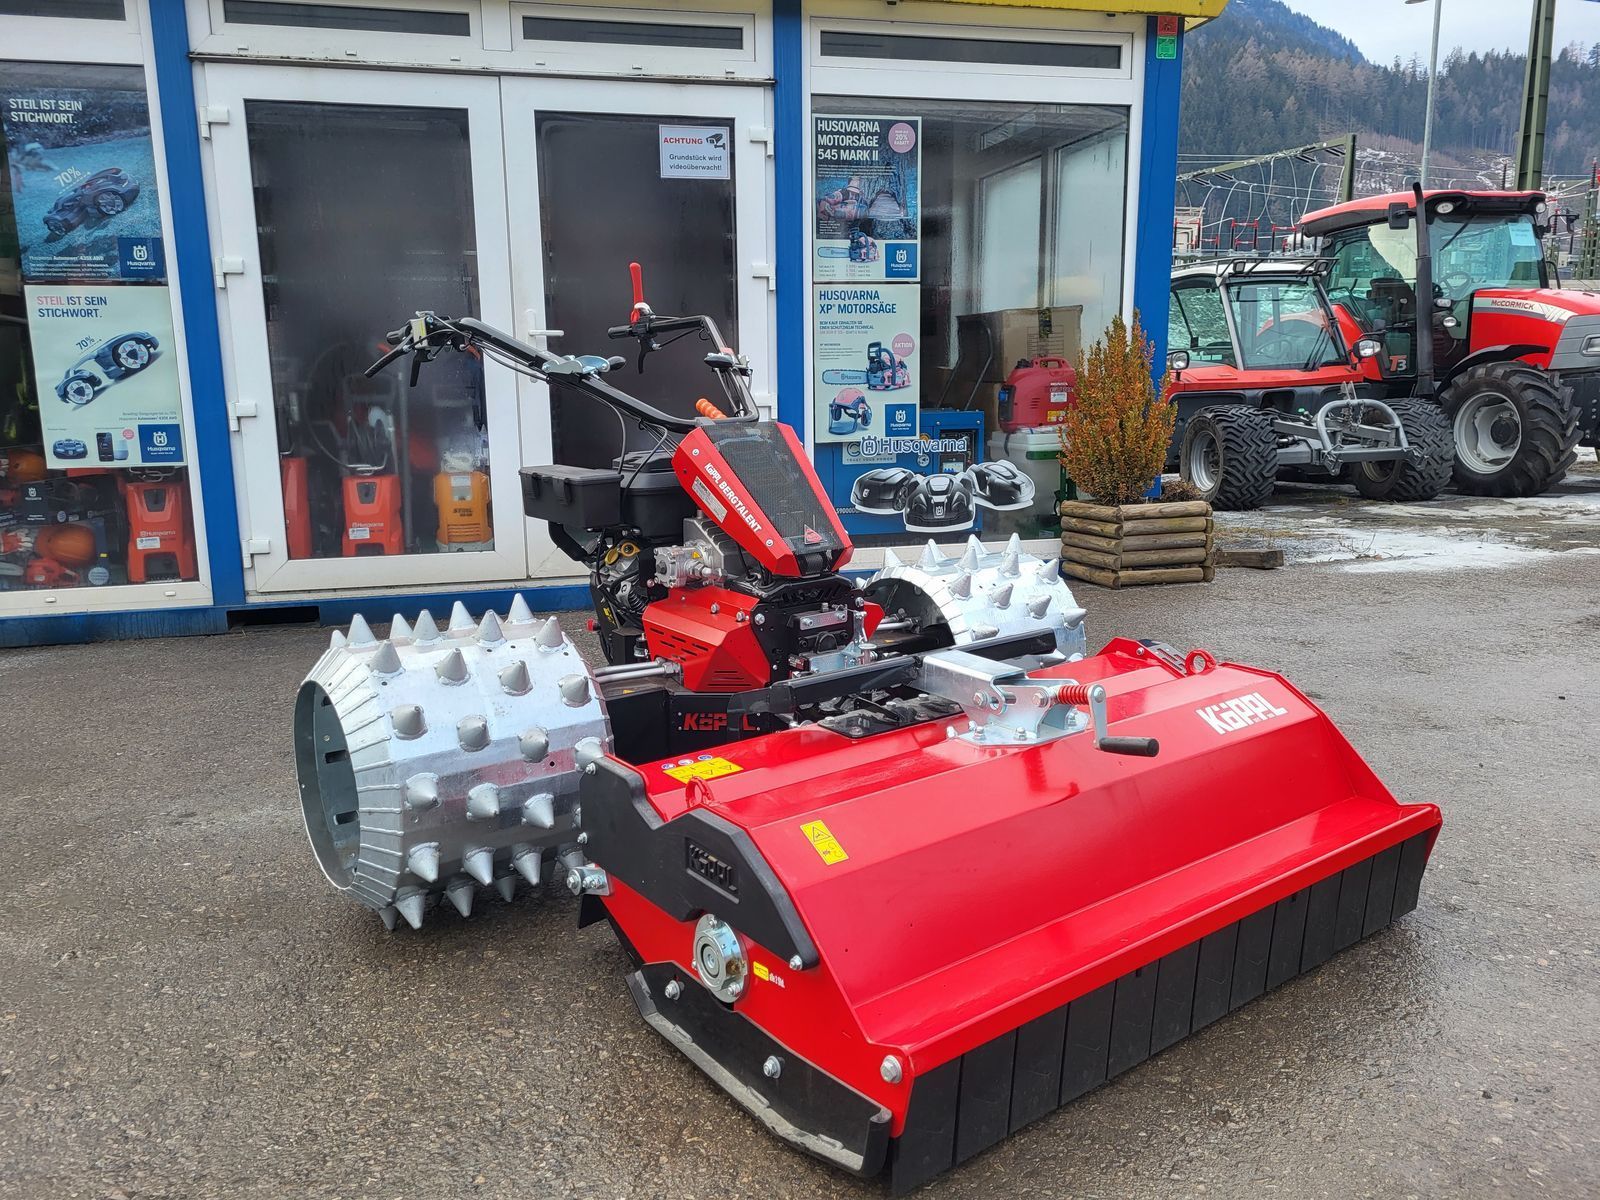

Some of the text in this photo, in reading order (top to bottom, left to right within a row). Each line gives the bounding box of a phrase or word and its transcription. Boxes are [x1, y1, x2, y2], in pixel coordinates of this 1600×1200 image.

[8, 98, 82, 111] STEIL IST SEIN
[11, 111, 78, 123] STICHWORT.
[817, 120, 881, 132] HUSQVARNA
[817, 133, 879, 146] MOTORSÄGE
[818, 149, 838, 160] 545
[840, 149, 870, 160] MARK
[53, 166, 81, 187] 70%
[36, 296, 108, 306] STEIL IST SEIN
[819, 290, 880, 301] HUSQVARNA
[38, 308, 102, 318] STICHWORT.
[837, 301, 897, 314] MOTORSÄGE
[75, 336, 95, 350] 70%
[1389, 354, 1407, 371] T3
[880, 438, 967, 455] Husqvarna
[718, 481, 762, 533] BERGTALENT
[683, 712, 756, 731] KÖPL
